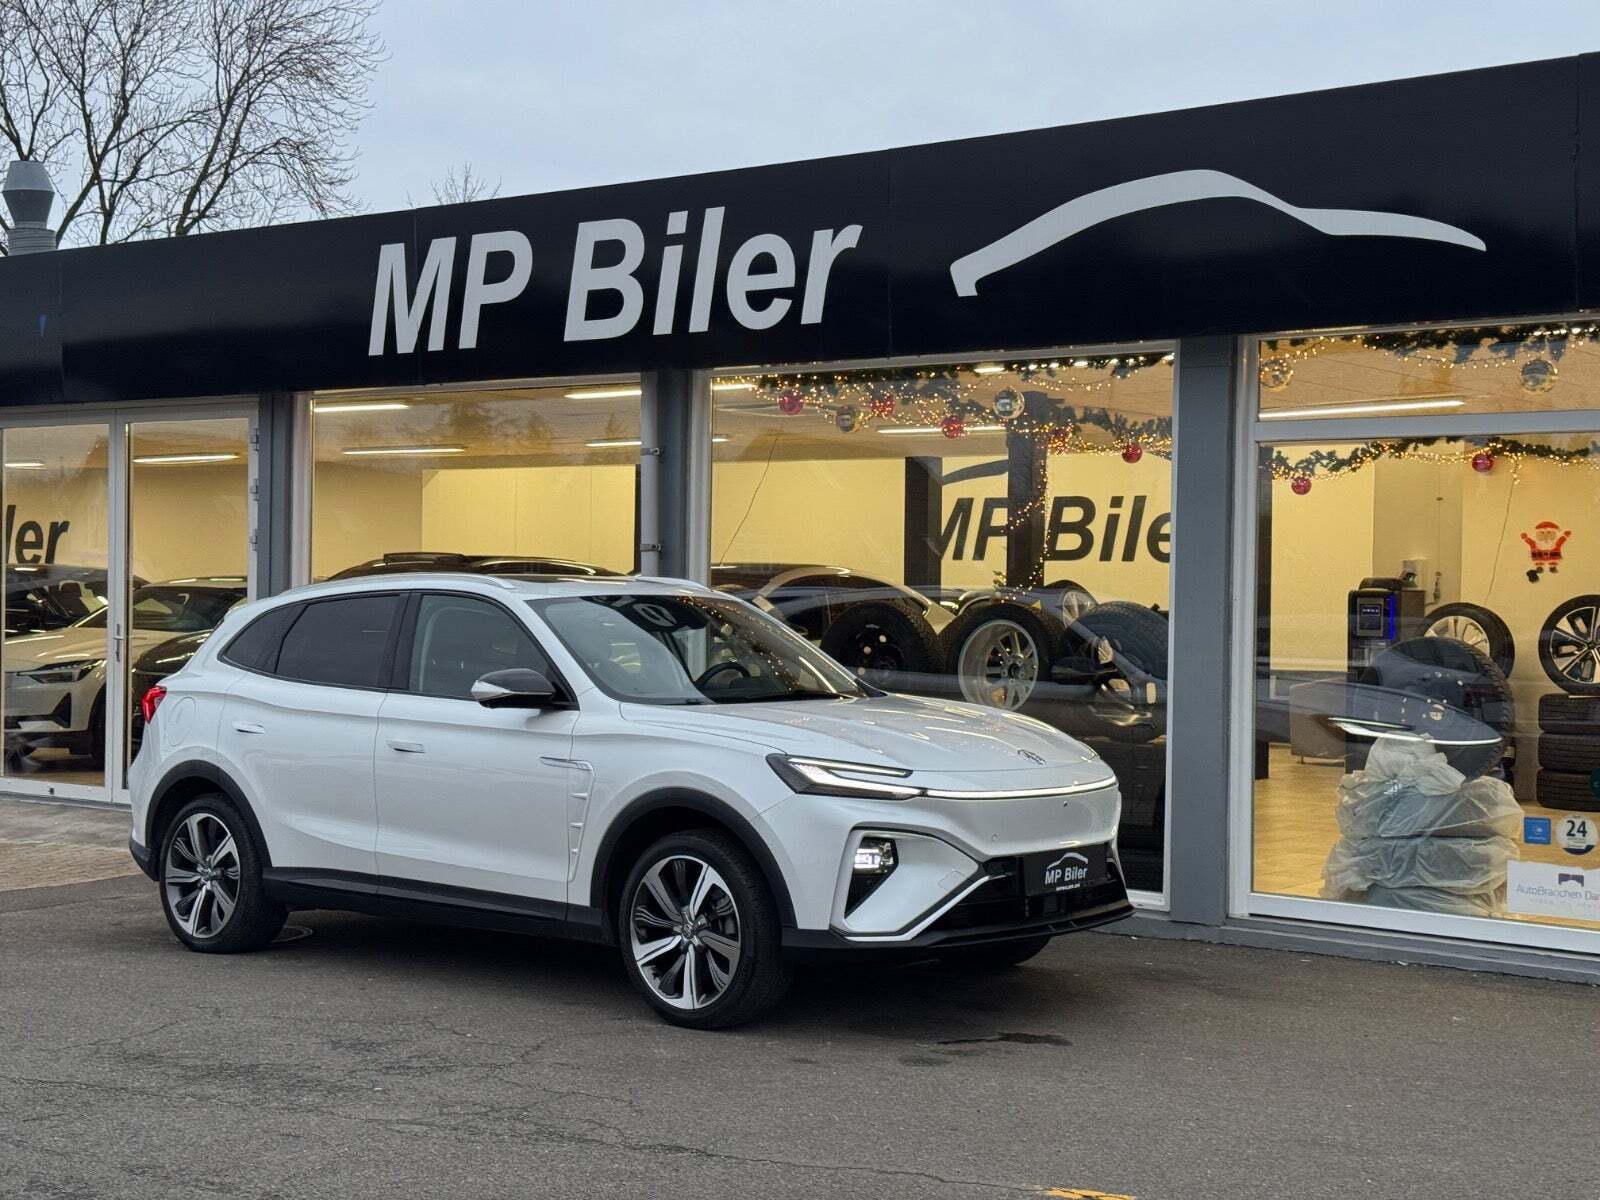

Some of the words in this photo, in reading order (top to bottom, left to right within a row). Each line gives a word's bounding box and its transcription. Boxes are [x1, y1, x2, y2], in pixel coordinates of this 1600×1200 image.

[368, 230, 533, 356] MP
[563, 206, 863, 342] Biler
[1566, 820, 1587, 837] 24
[1045, 869, 1062, 884] MP
[1064, 866, 1088, 881] Biler
